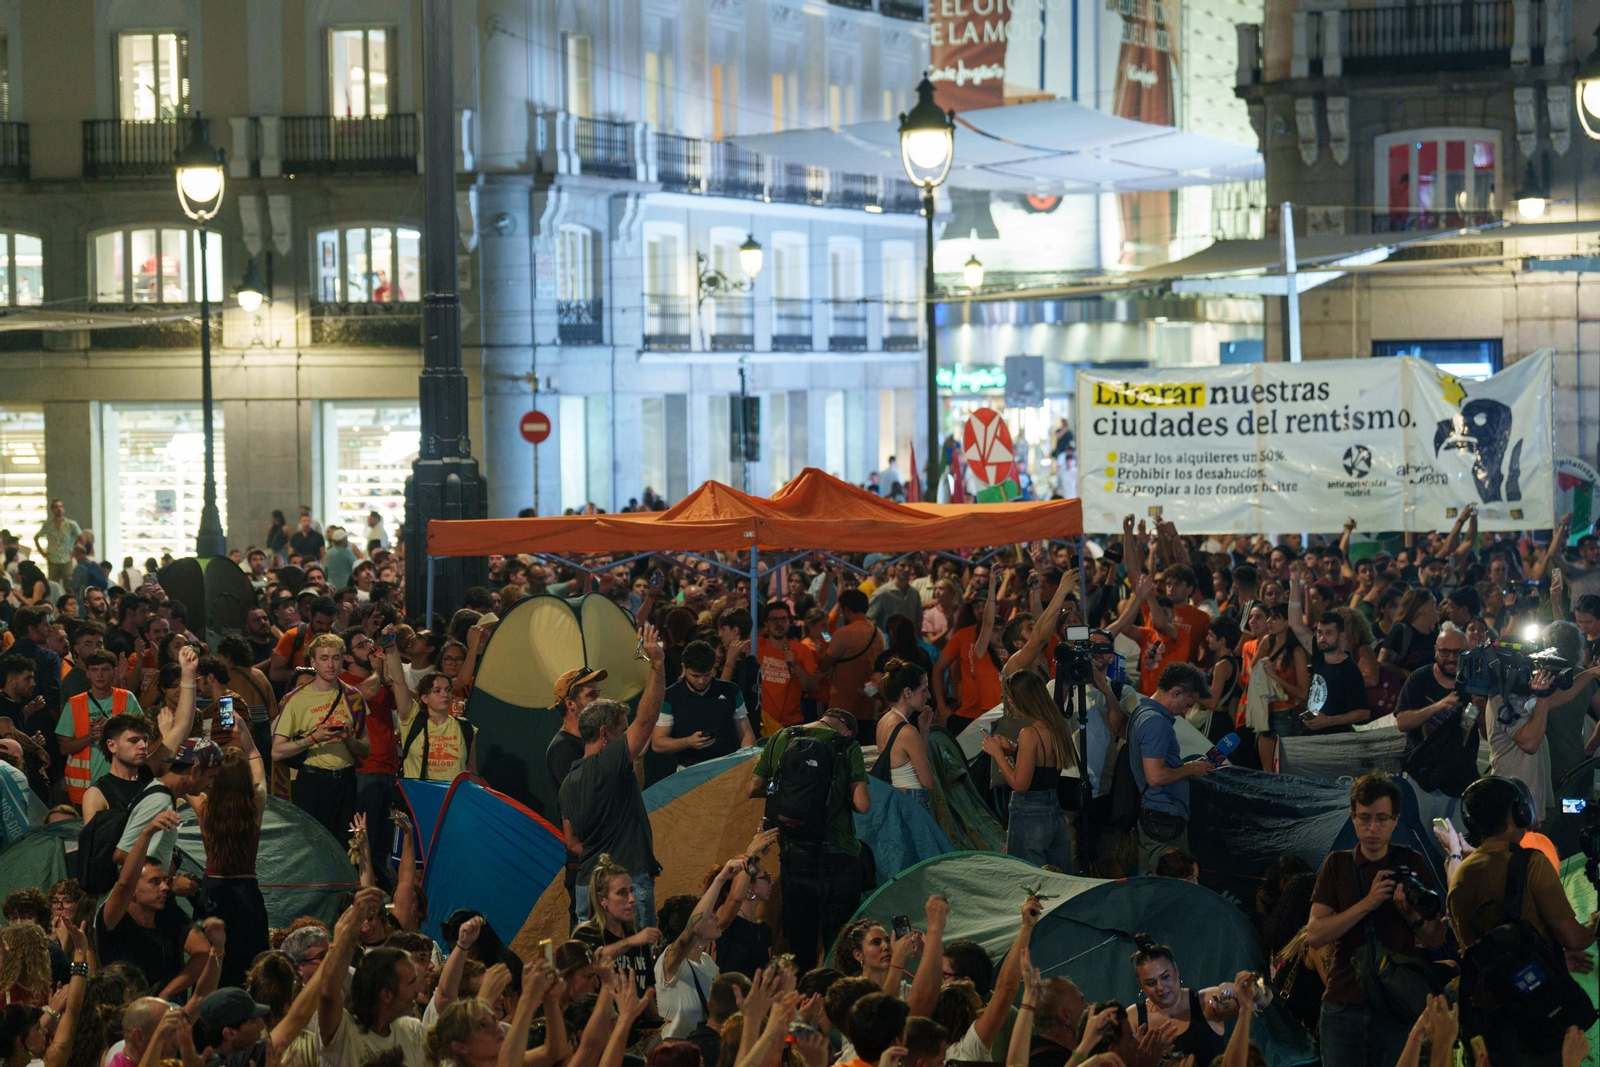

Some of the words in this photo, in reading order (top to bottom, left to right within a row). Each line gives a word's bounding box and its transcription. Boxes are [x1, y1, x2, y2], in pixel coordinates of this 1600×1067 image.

[949, 21, 980, 45] LA
[1096, 382, 1203, 406] Liberar
[1210, 380, 1330, 405] nuestras
[1093, 410, 1229, 437] ciudades
[1236, 409, 1278, 436] del
[1285, 404, 1417, 434] rentismo.
[1119, 452, 1152, 467] Bajar
[1155, 452, 1173, 464] los
[1176, 452, 1239, 466] alquileres
[1242, 453, 1258, 463] un
[1117, 467, 1171, 480] Prohibir
[1174, 467, 1193, 480] los
[1116, 481, 1181, 497] Expropiar
[1184, 485, 1191, 495] a
[1194, 483, 1213, 496] los
[1215, 482, 1259, 495] fondos
